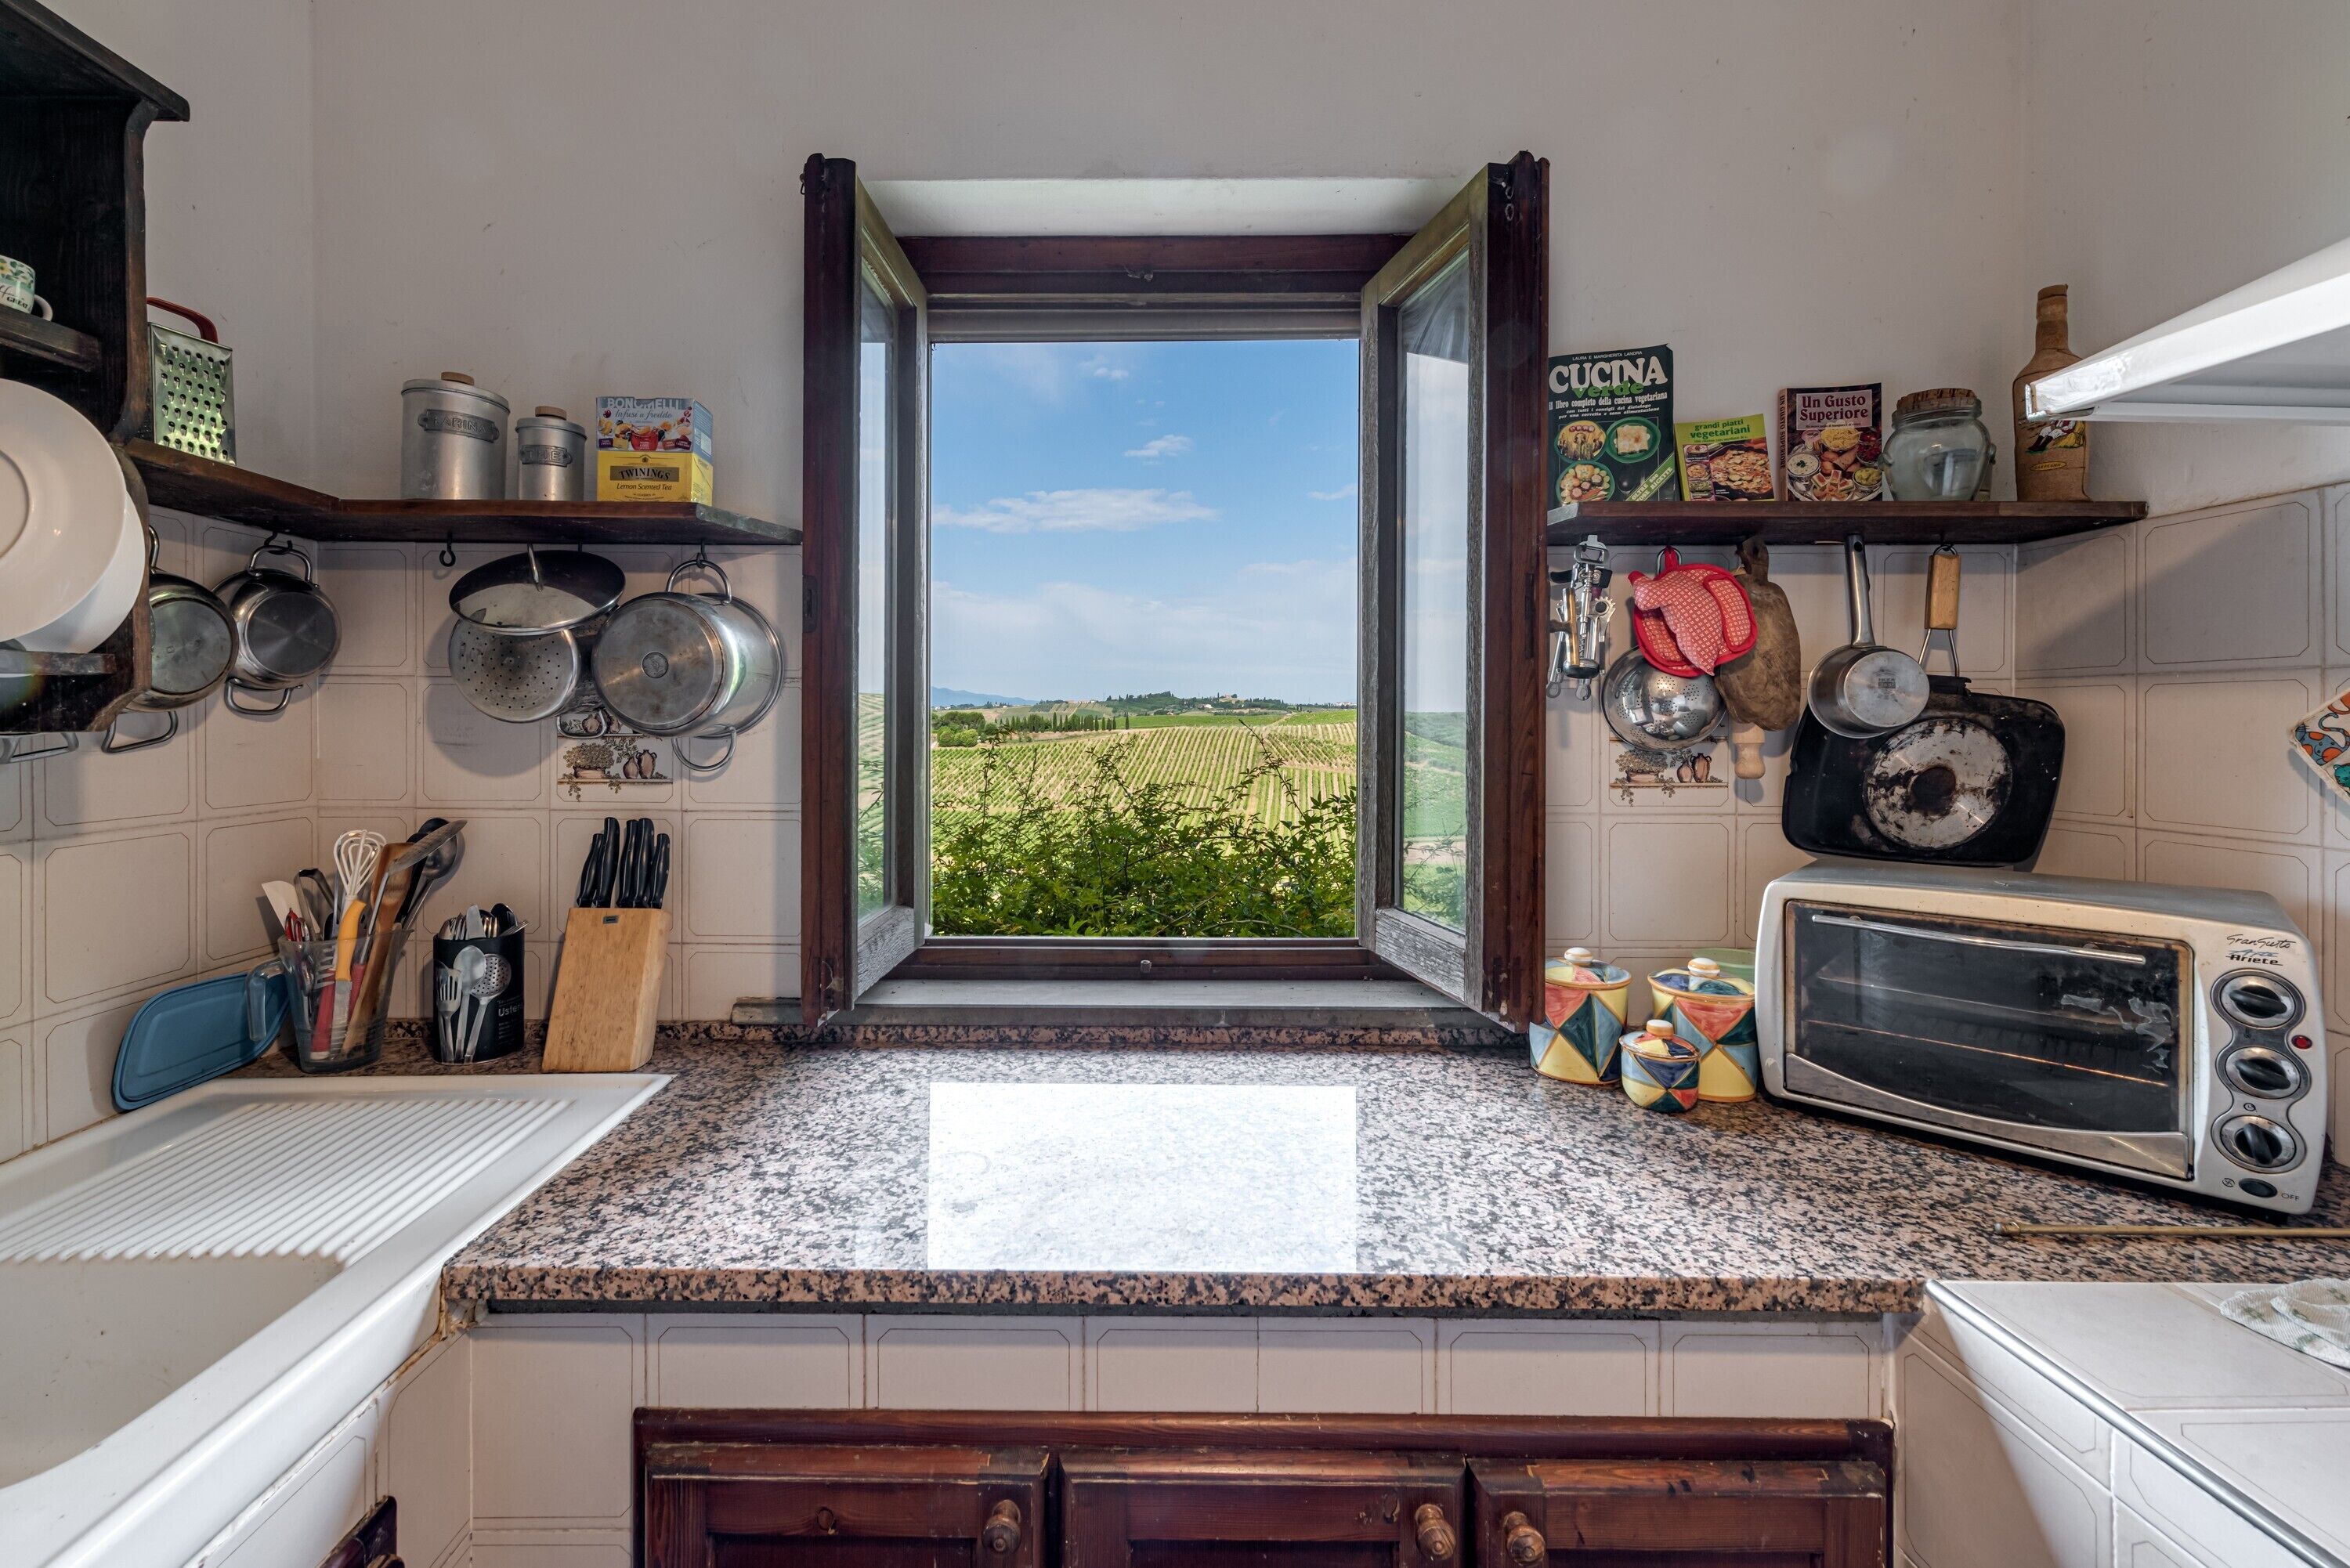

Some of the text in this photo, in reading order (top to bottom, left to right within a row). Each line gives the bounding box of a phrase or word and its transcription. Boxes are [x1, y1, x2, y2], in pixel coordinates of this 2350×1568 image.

[1549, 356, 1668, 394] CUCINA
[1571, 380, 1644, 398] verde
[1549, 392, 1668, 410] il libro completo della cucina vegetariana
[1802, 395, 1866, 408] Un Gusto
[615, 410, 638, 420] Infusi
[644, 410, 672, 420] freddo
[1799, 408, 1868, 423] Superiore
[1690, 425, 1750, 439] vegetariani
[1694, 419, 1744, 432] grandi piatti
[619, 468, 671, 480] TWININGS
[1632, 482, 1649, 500] OLTRE
[1636, 467, 1673, 501] TOSE RICETTE
[2225, 954, 2283, 966] Ariete
[2281, 1193, 2301, 1201] OFF
